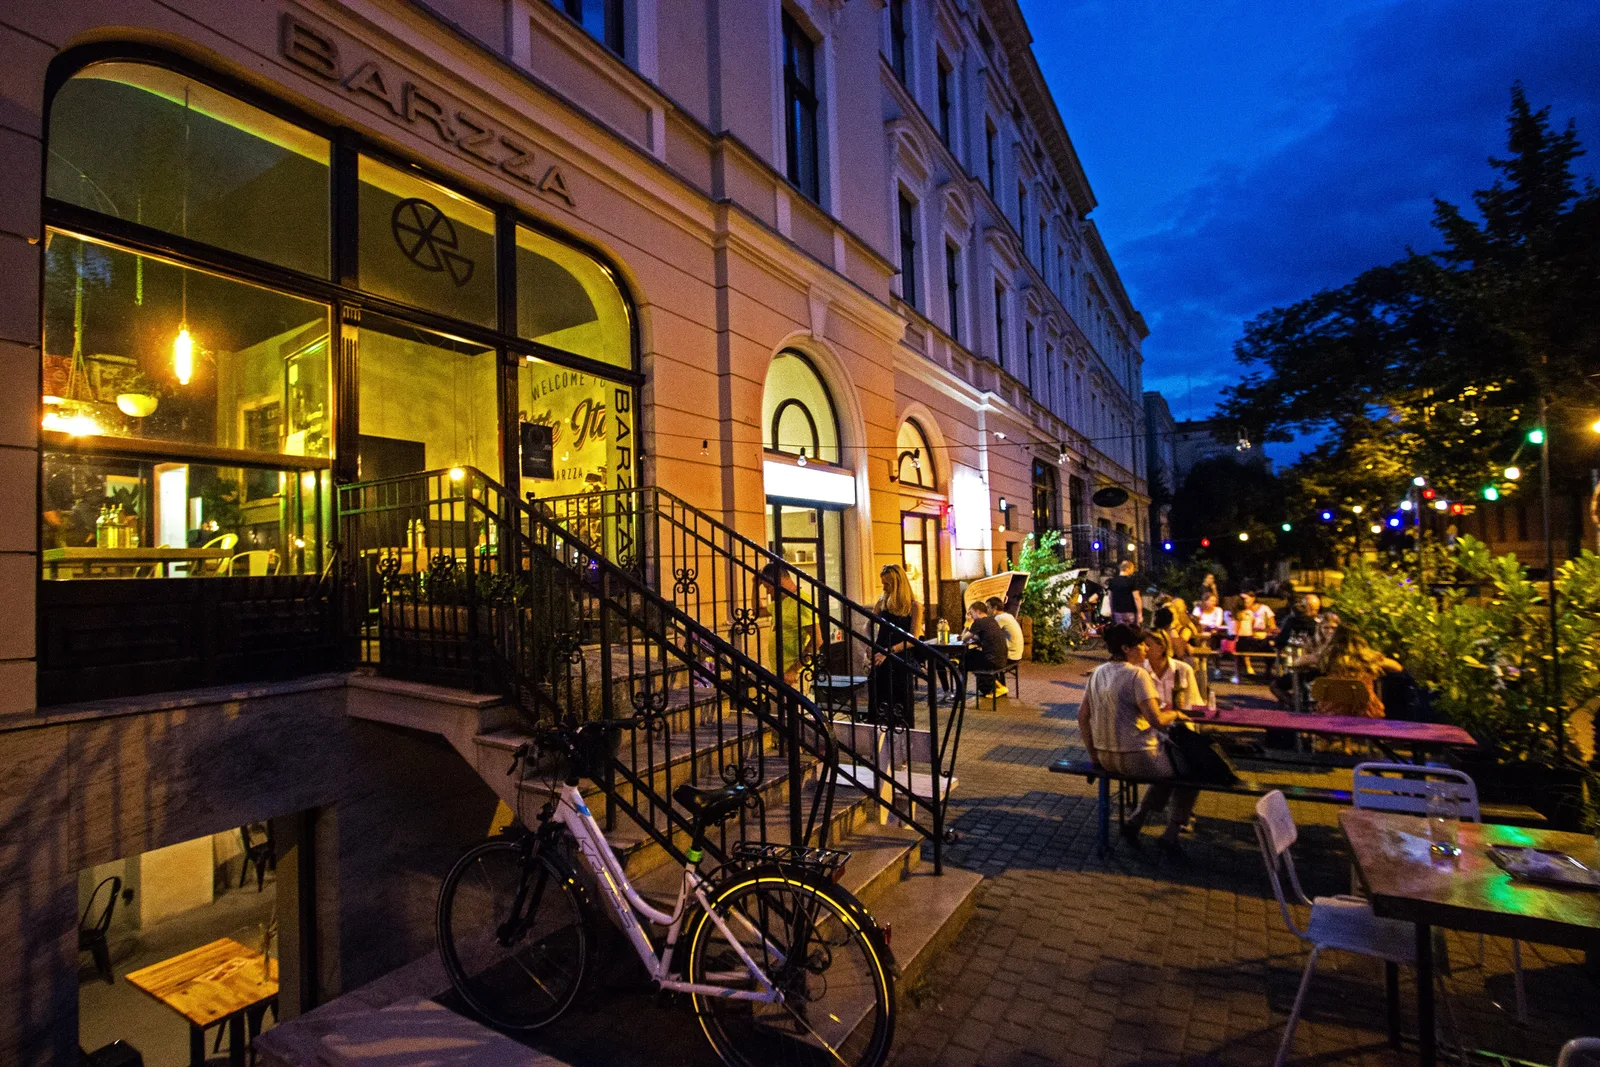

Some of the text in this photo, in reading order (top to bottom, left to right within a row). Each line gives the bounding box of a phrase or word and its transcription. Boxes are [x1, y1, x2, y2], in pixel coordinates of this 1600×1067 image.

[277, 10, 576, 207] BARZZA
[531, 372, 585, 401] WELCOME
[615, 388, 634, 555] BARZZA
